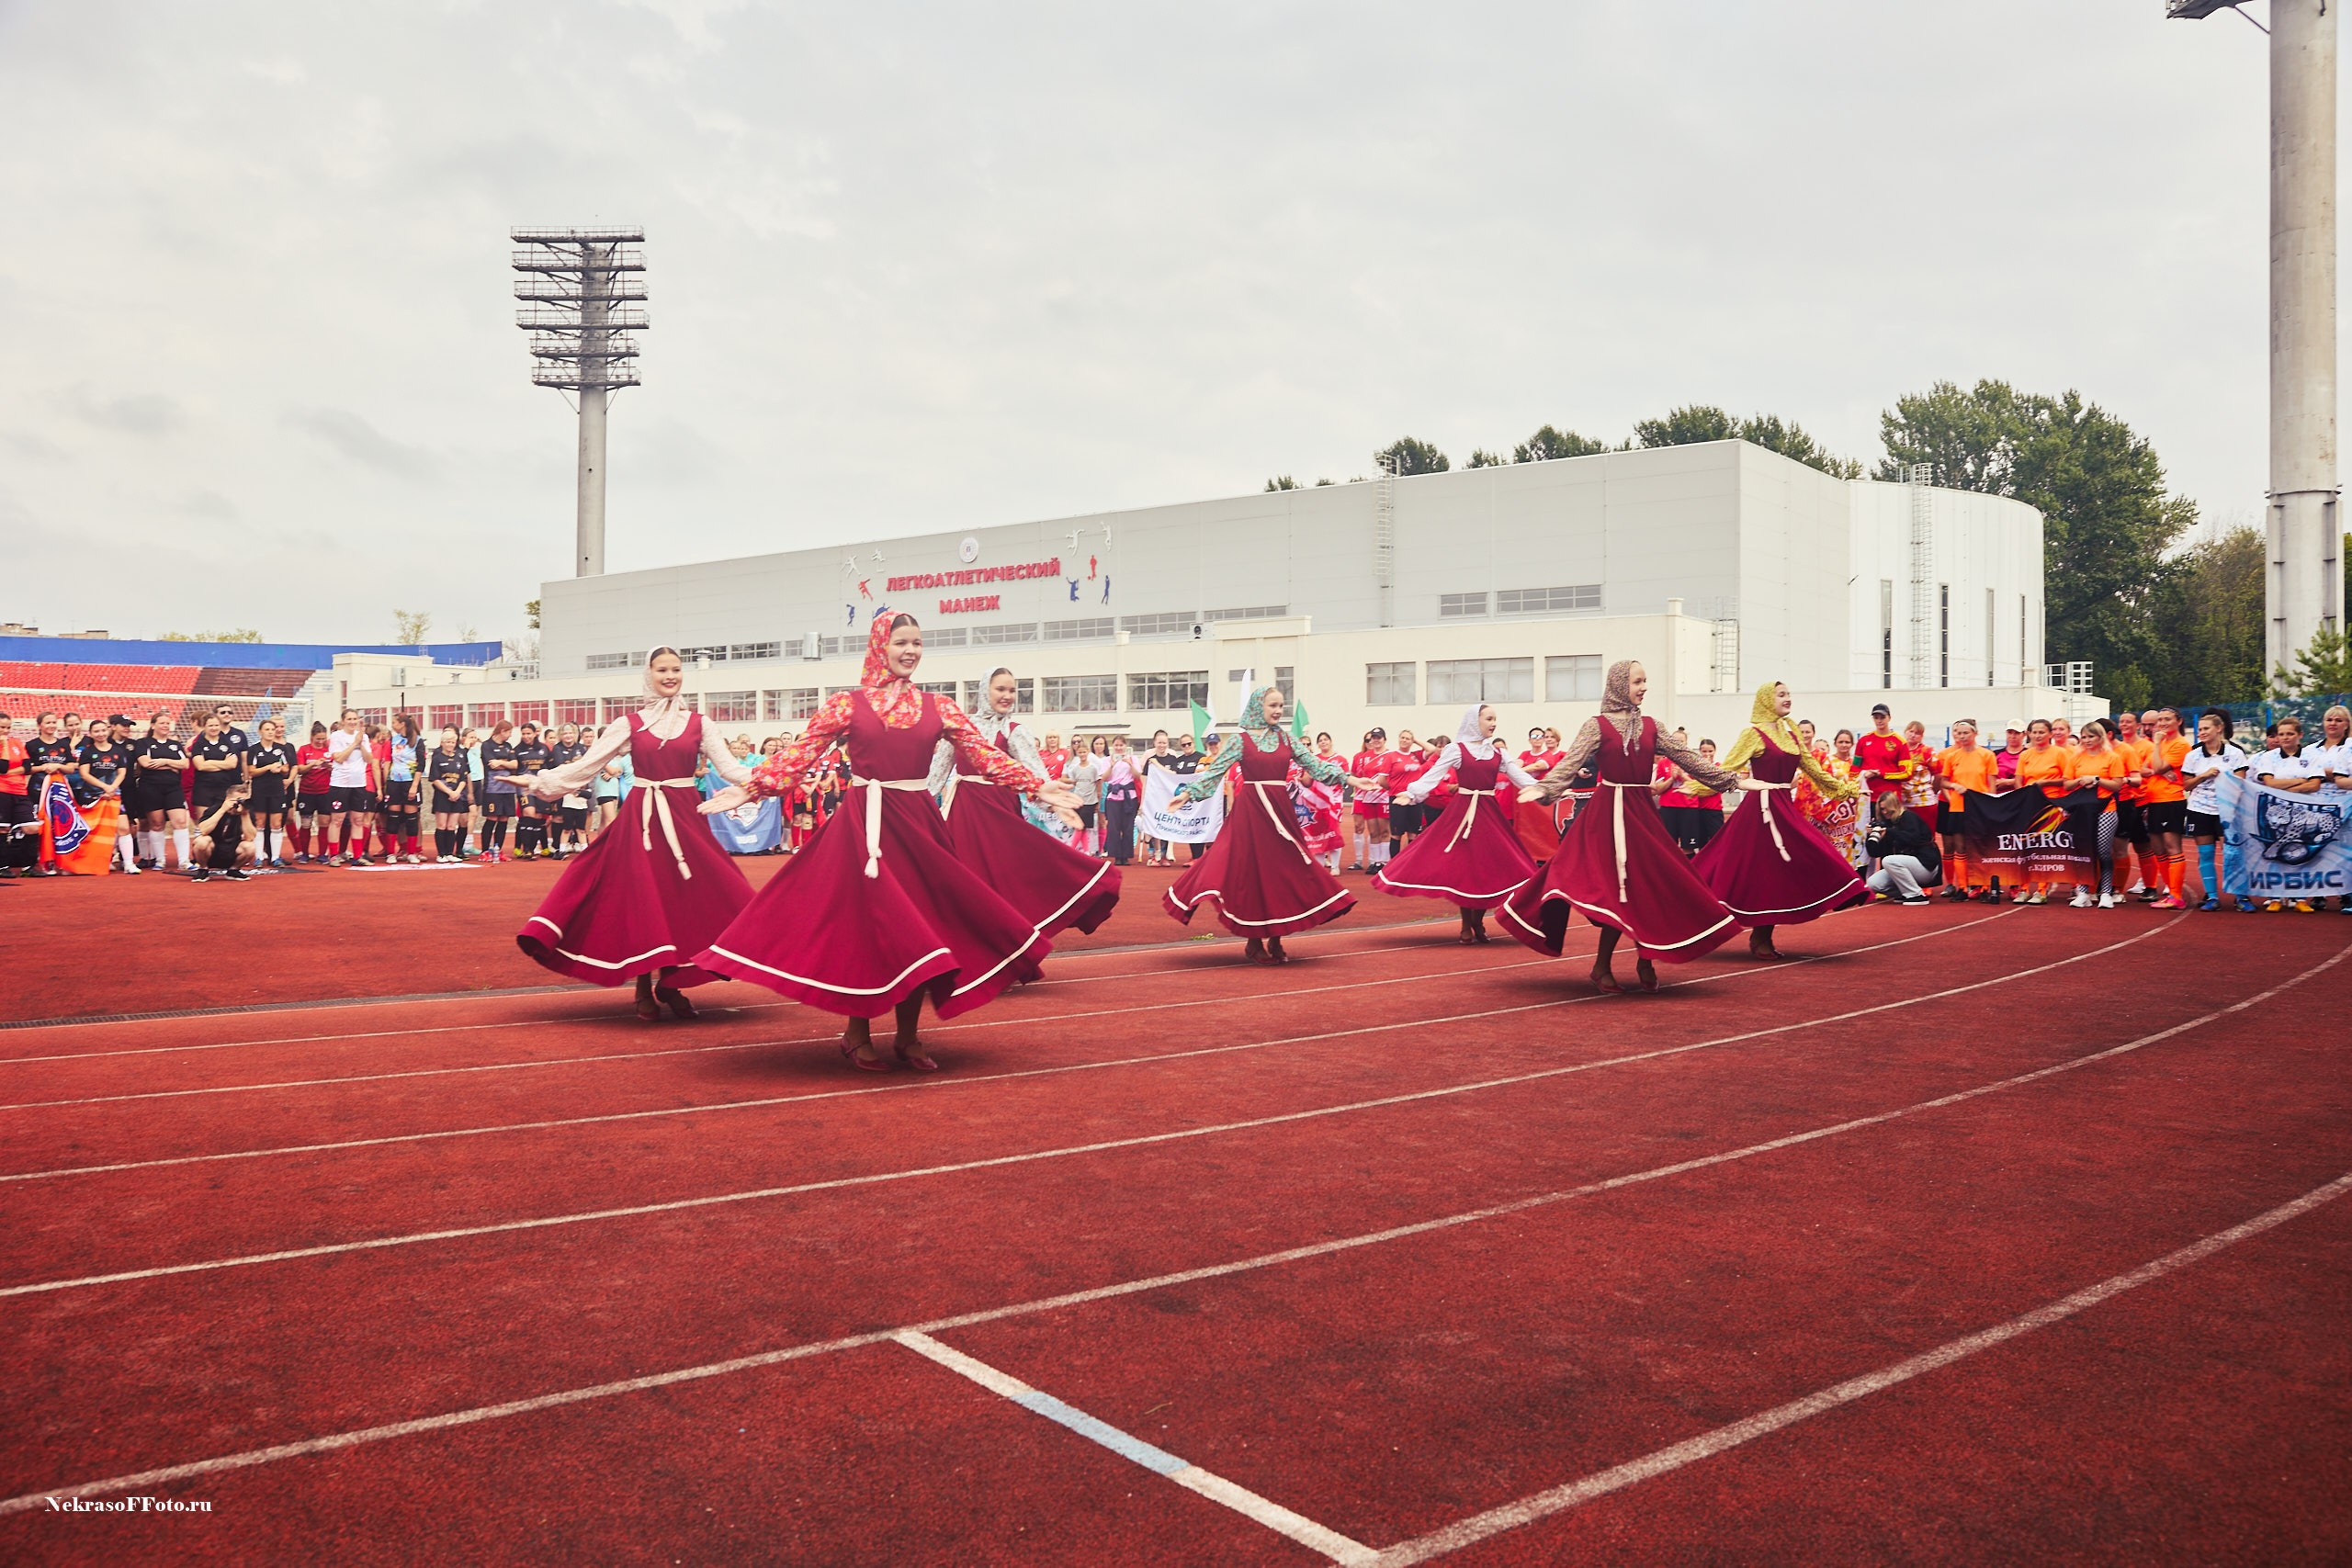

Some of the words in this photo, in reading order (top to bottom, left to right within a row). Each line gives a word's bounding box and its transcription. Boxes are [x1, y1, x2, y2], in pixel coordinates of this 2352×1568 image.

[887, 558, 1060, 592] ЛЕГКОАТЛЕТИЧЕСКИЙ
[940, 595, 1000, 614] МАНЕЖ
[2250, 870, 2344, 890] ИРБИС
